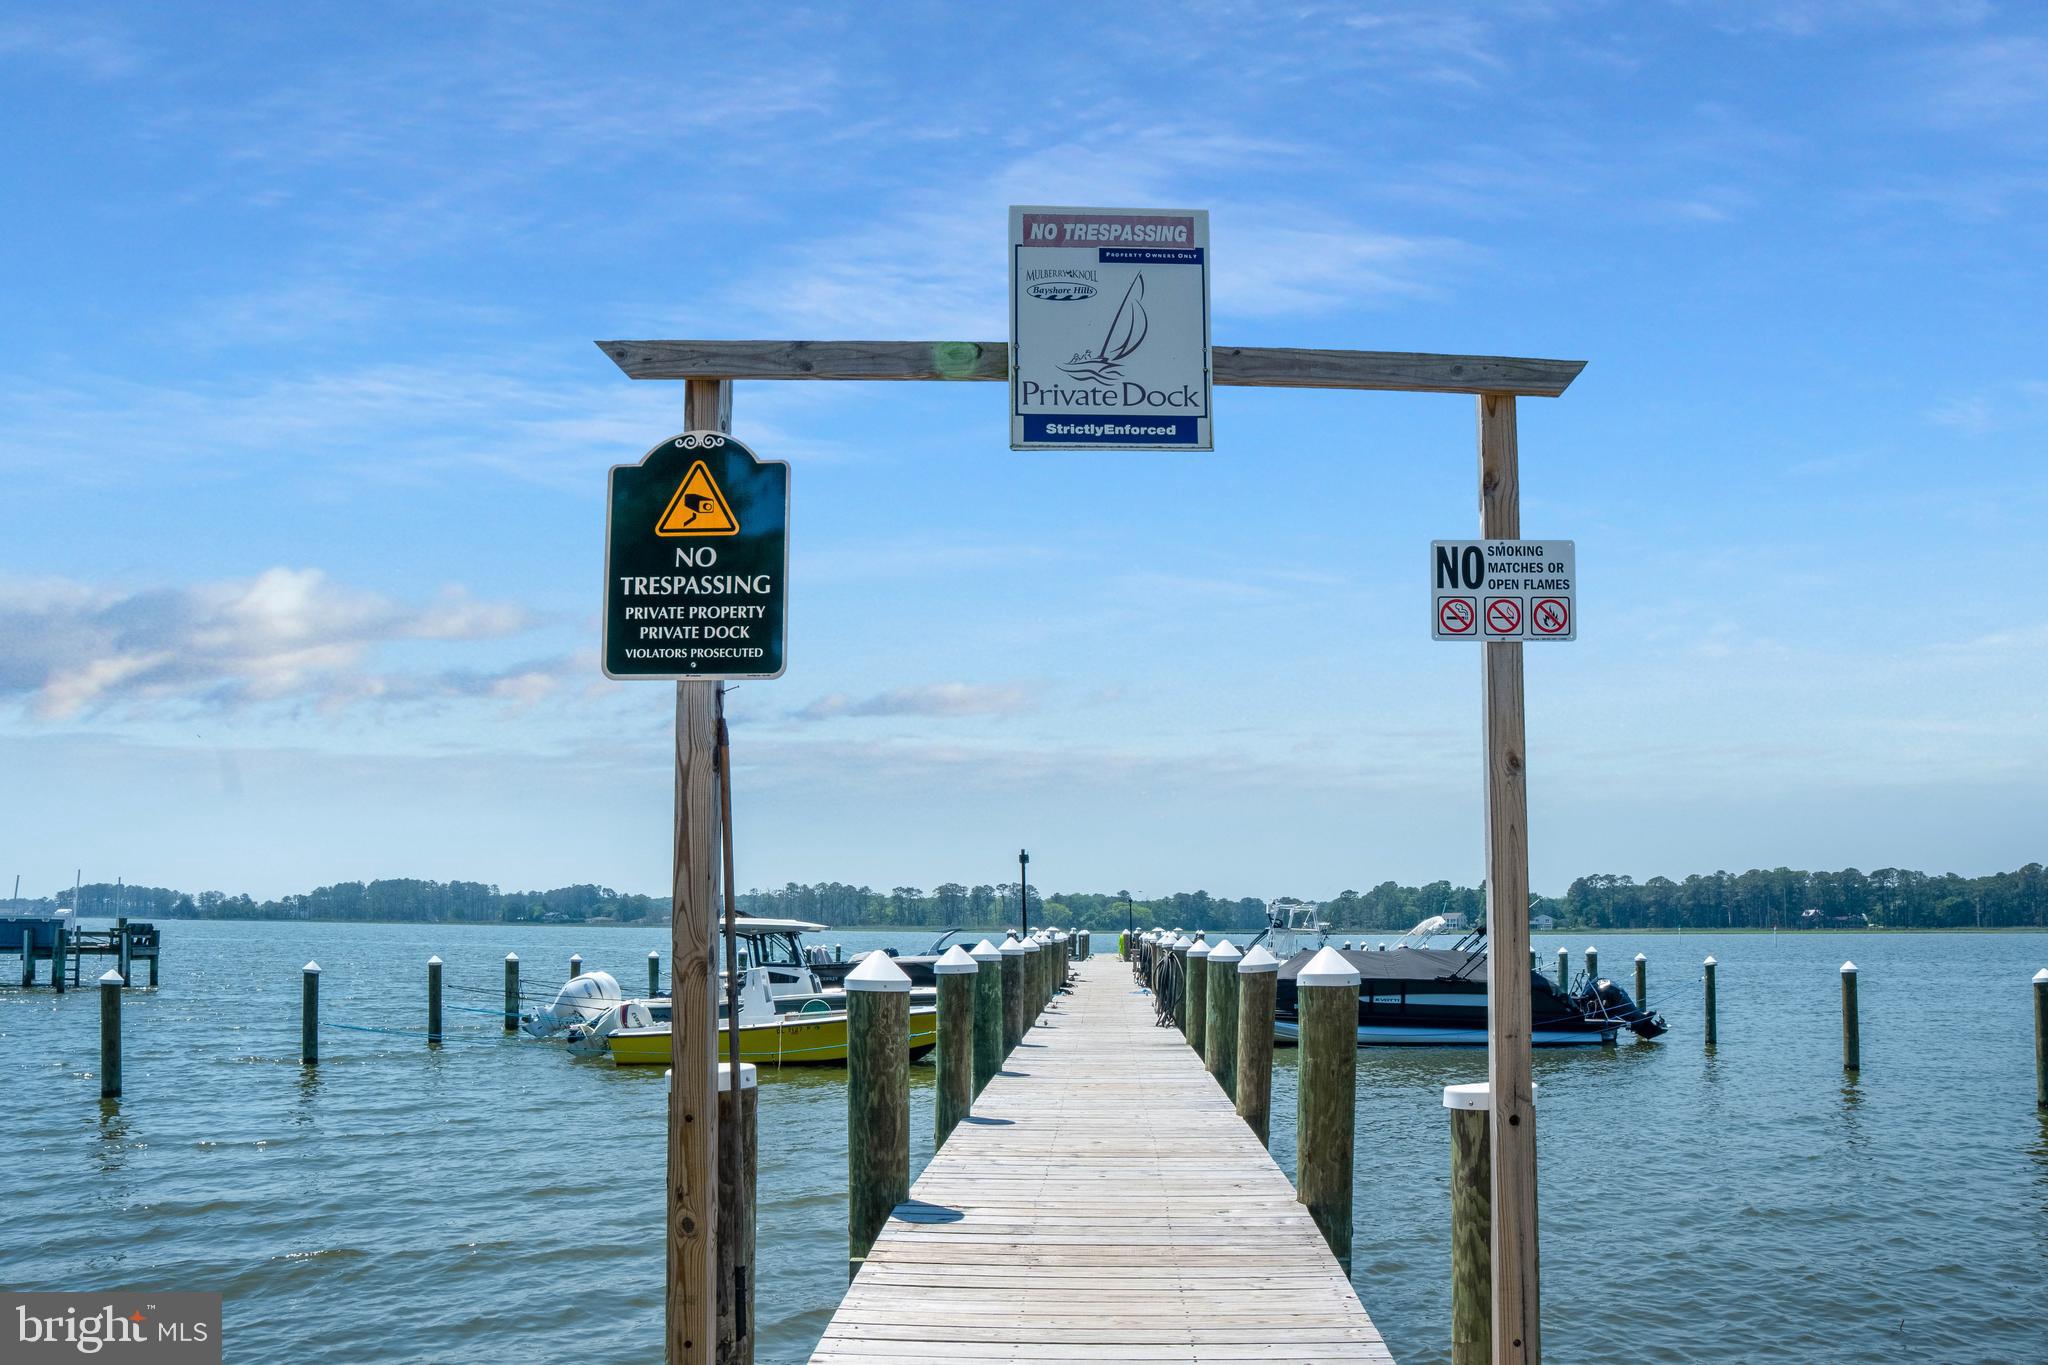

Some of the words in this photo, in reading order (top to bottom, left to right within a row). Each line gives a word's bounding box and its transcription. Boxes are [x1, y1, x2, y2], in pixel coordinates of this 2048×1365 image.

[1030, 223, 1057, 240] NO
[1063, 223, 1188, 242] TRESPASSING
[1026, 269, 1067, 282] MULBERRY
[1072, 269, 1099, 282] KNOLL
[1033, 286, 1071, 295] Bayshore
[1073, 286, 1093, 295] Hills
[1022, 381, 1118, 407] Private
[1122, 382, 1200, 408] Dock
[675, 547, 717, 568] NO
[1487, 545, 1543, 557] SMOKING
[1436, 545, 1485, 590] NO
[1488, 562, 1544, 573] MATCHES
[1547, 562, 1564, 573] OR
[620, 575, 771, 596] TRESPASSING
[1488, 579, 1519, 590] OPEN
[1524, 579, 1570, 590] FLAMES
[625, 606, 685, 619] PRIVATE
[689, 605, 766, 619] PROPERTY
[639, 626, 699, 639] PRIVATE
[704, 625, 750, 639] DOCK
[625, 648, 688, 658] VIOLATORS
[690, 647, 764, 658] PROSECUTED
